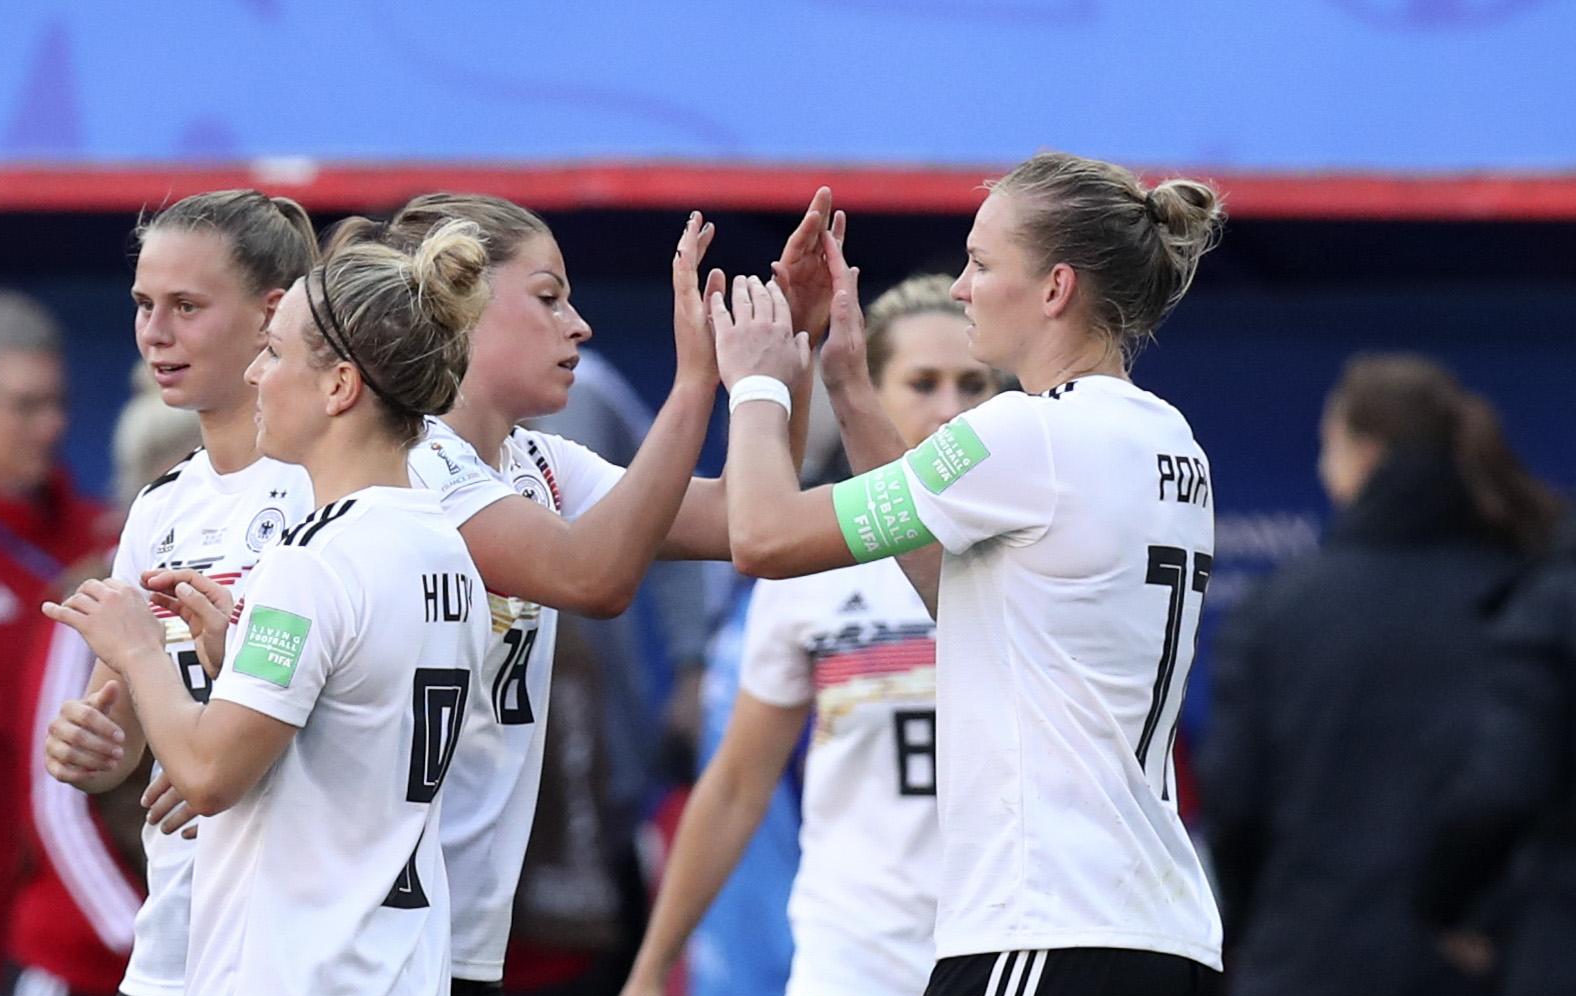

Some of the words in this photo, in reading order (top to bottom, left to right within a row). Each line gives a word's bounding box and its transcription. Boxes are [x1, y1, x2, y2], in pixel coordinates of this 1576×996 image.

[932, 458, 953, 482] FIFA
[853, 514, 880, 553] FIFA
[250, 633, 297, 652] FOOTBALL
[252, 624, 300, 645] LIVING
[267, 652, 292, 668] FIFA
